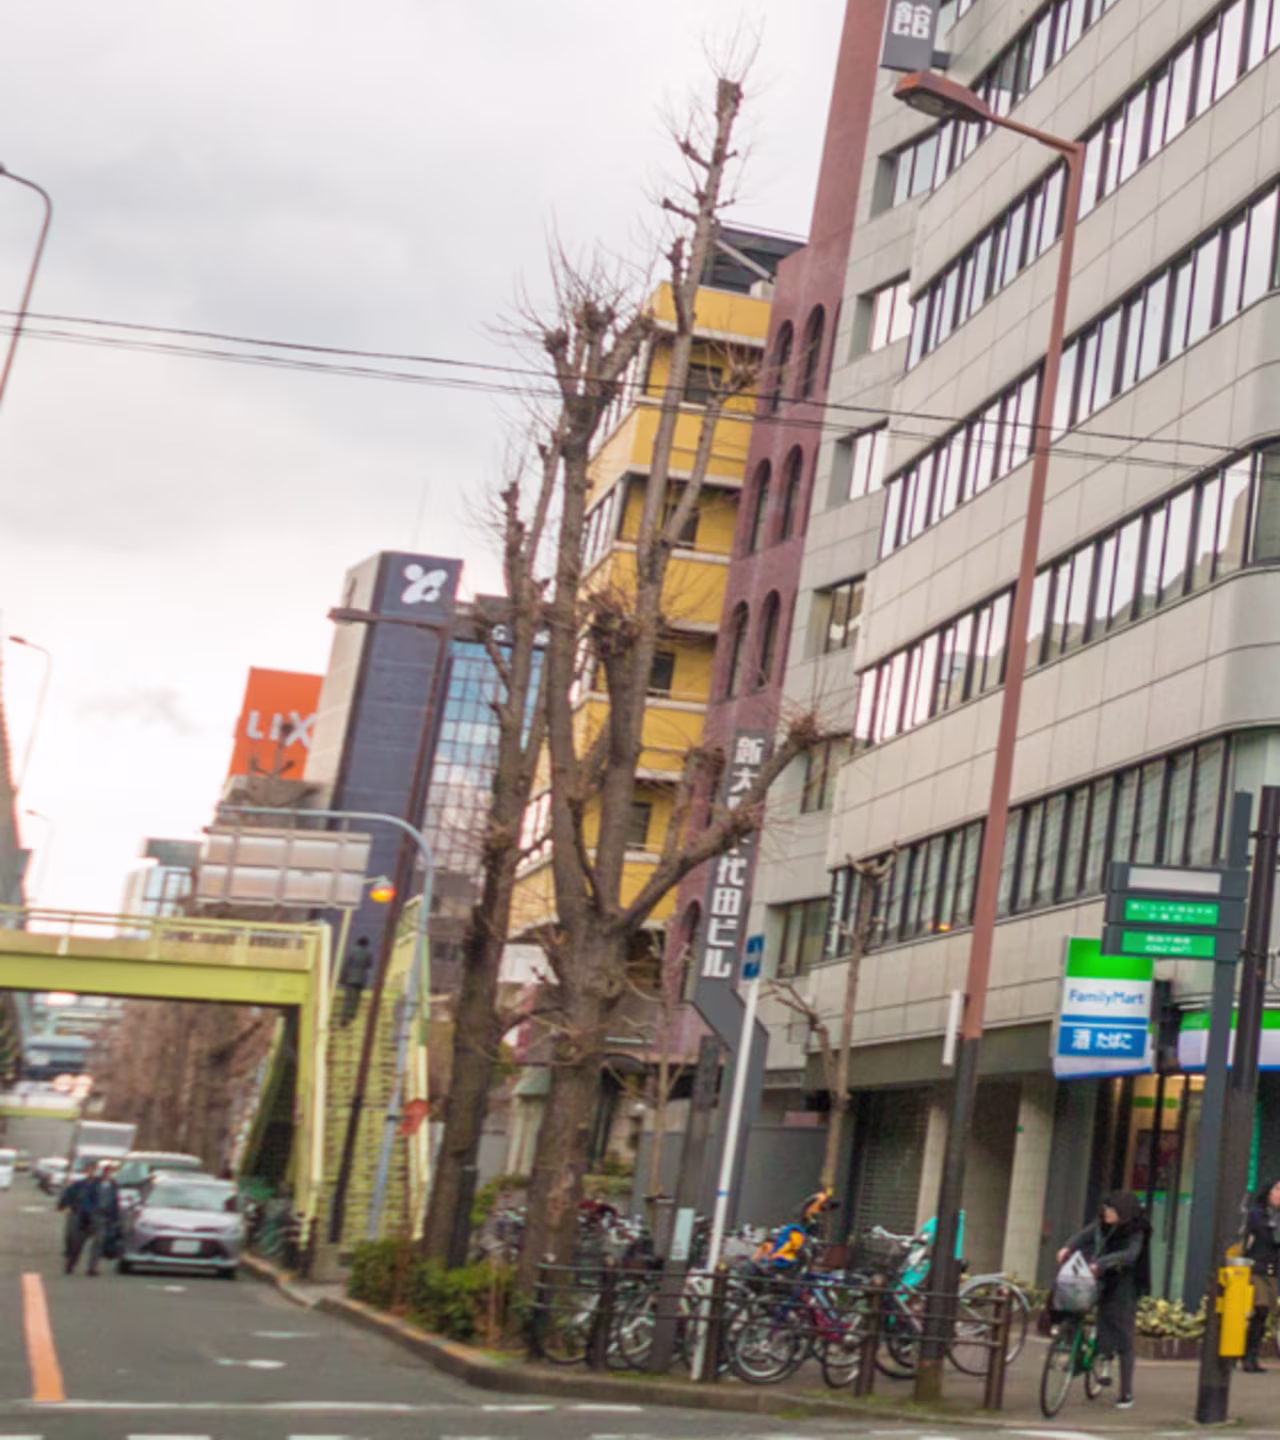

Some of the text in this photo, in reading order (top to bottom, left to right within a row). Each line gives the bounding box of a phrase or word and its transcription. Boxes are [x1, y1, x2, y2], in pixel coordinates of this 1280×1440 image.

[246, 708, 319, 750] LIX
[701, 735, 767, 979] 新大代田ビル
[1068, 988, 1145, 1008] FamilyMart
[1095, 1031, 1134, 1051] たばこ
